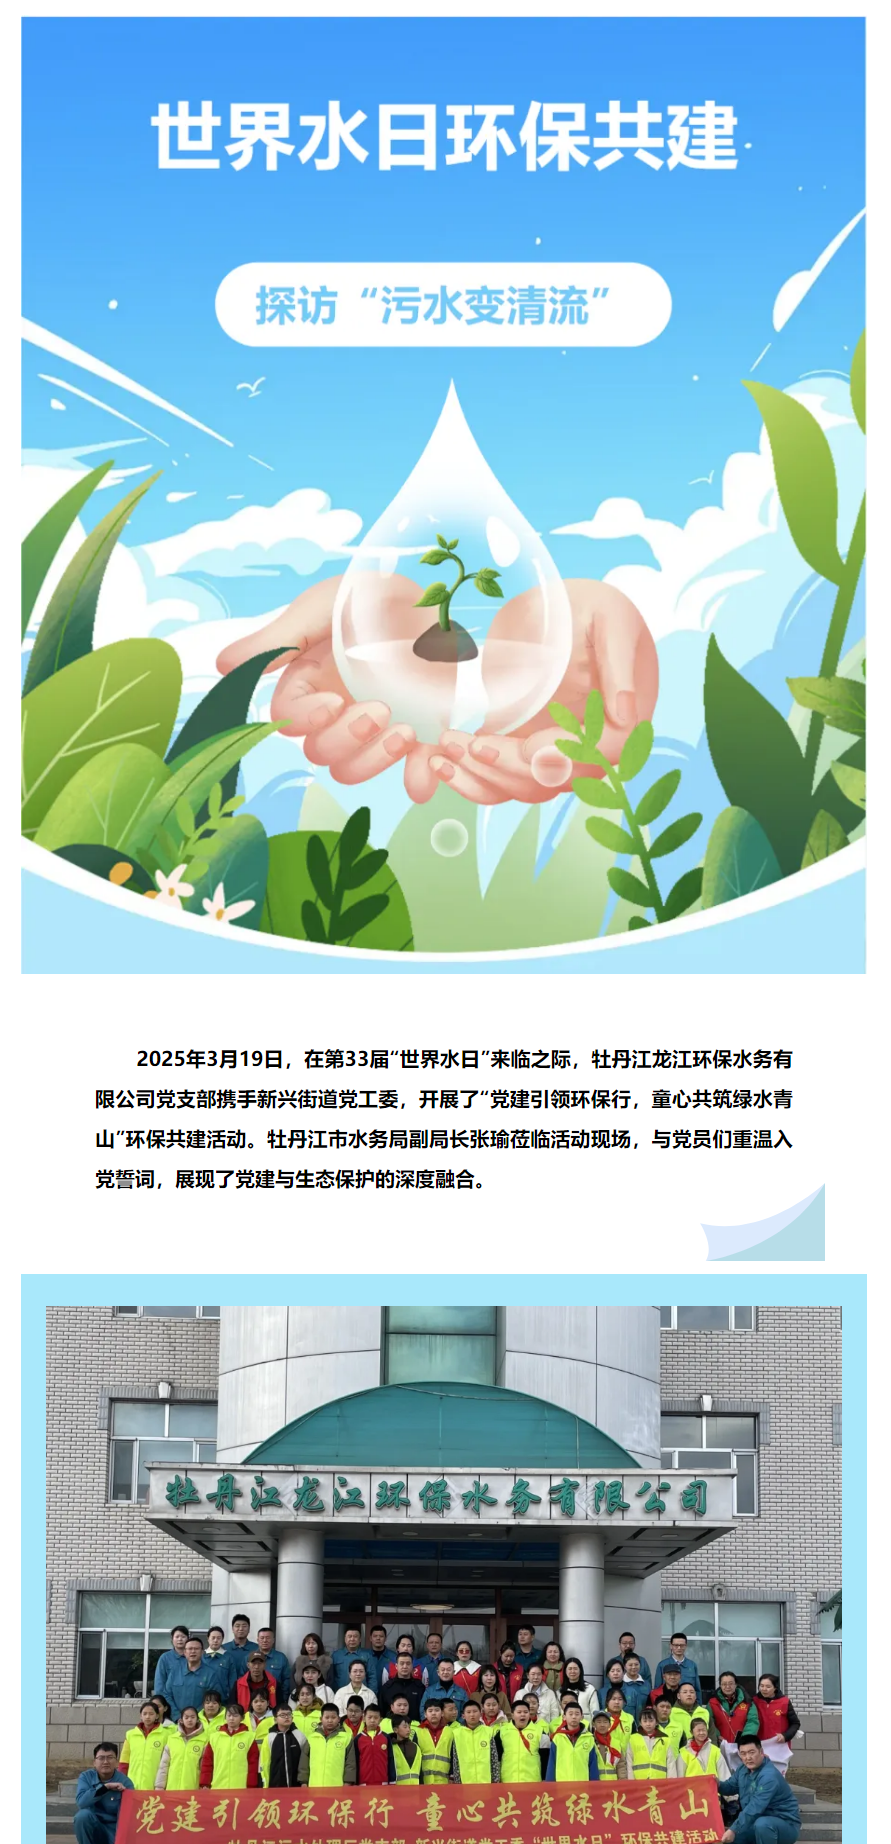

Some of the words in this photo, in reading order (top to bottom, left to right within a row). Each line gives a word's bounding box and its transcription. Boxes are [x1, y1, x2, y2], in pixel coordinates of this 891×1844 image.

[165, 1473, 708, 1516] 牡丹江龙江环保水务有限公司
[136, 1795, 394, 1834] 党建引领环保行
[416, 1785, 710, 1832] 童心共筑绿水青山
